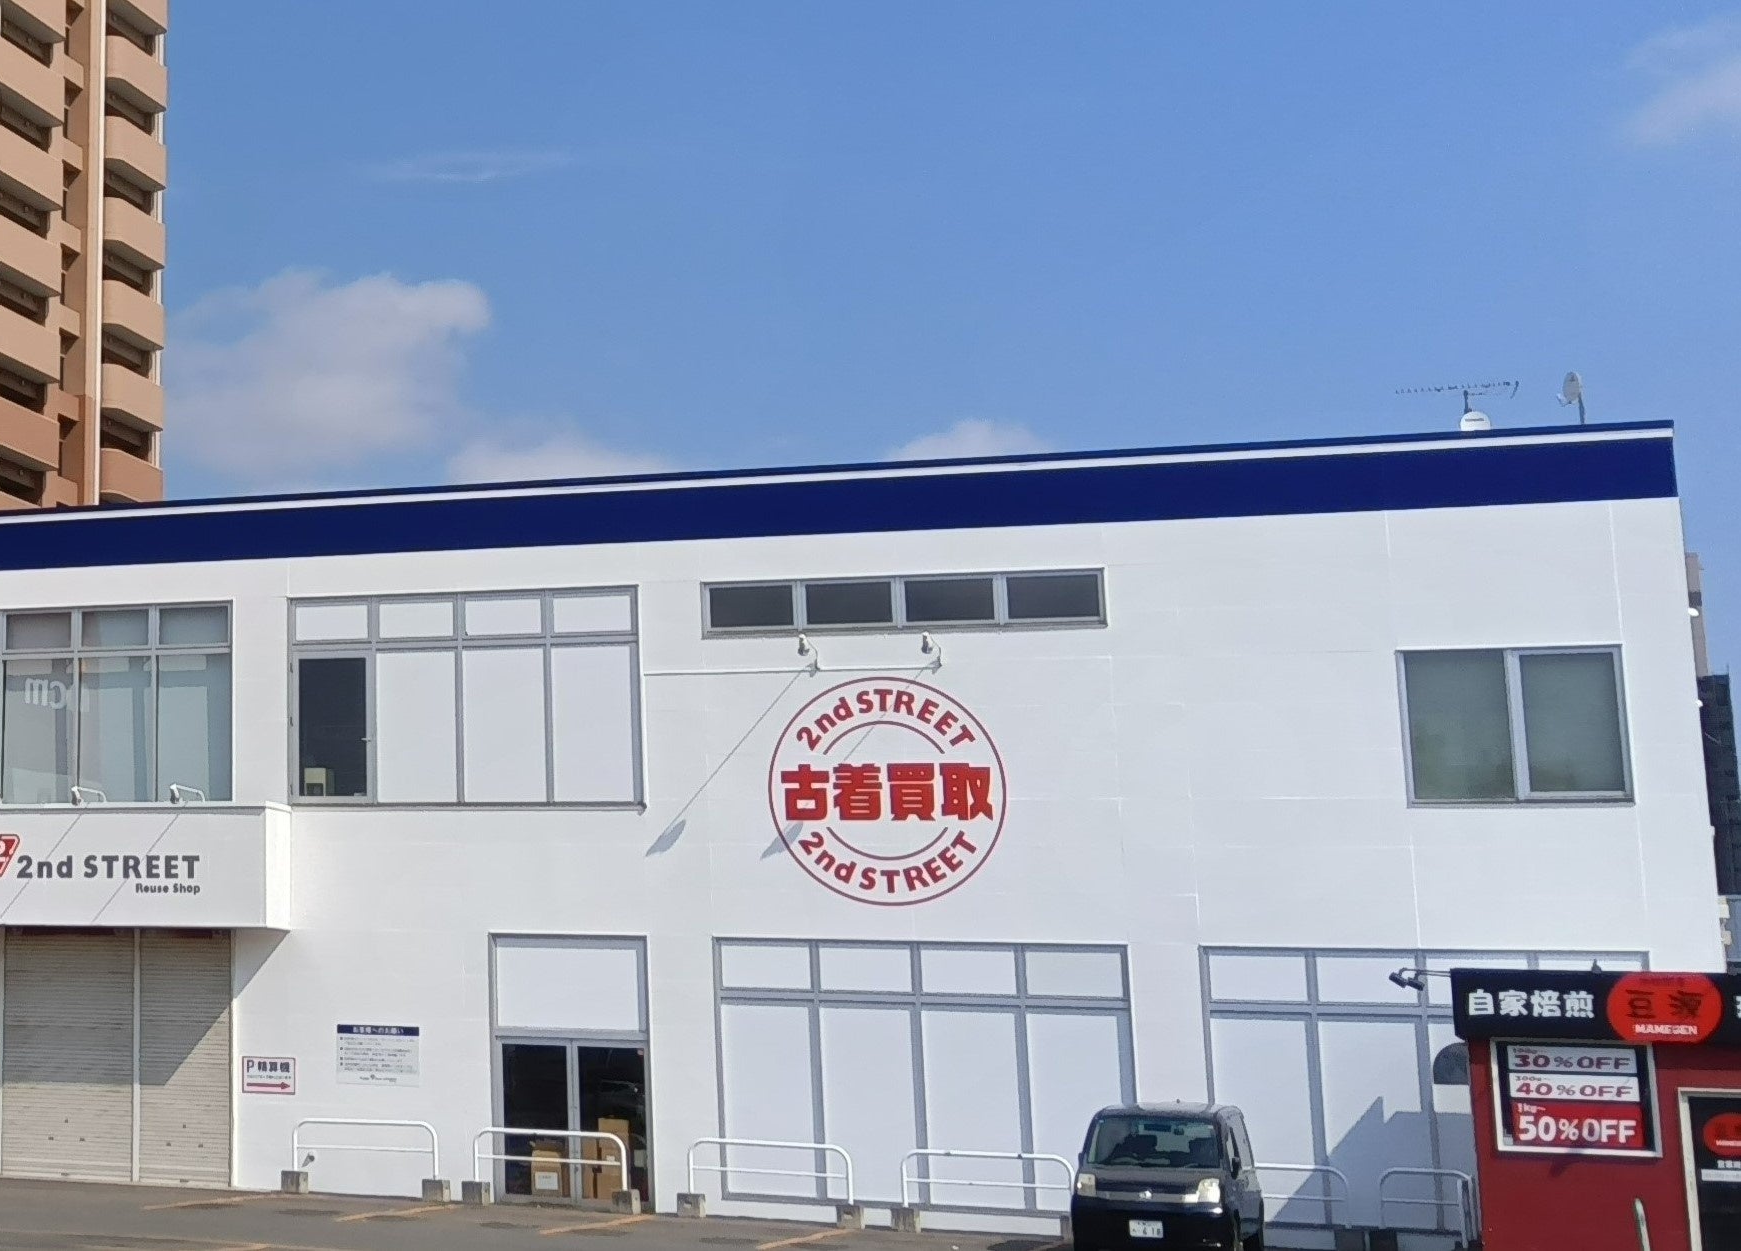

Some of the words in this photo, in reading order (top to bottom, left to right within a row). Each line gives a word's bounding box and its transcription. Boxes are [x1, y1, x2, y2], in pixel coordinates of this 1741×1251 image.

[796, 696, 854, 751] 2nd
[856, 688, 976, 747] STREET
[780, 763, 994, 822] 古着買取
[16, 855, 73, 879] 2nd
[83, 855, 200, 879] STREET
[798, 831, 857, 884] 2nd
[859, 830, 977, 894] STREET
[135, 883, 169, 894] Reuse
[172, 883, 201, 895] Shop
[1468, 989, 1595, 1019] 自家焙煎
[247, 1059, 255, 1073] P
[1514, 1054, 1631, 1070] 30%OFF
[1516, 1082, 1633, 1097] 40%OFF
[1519, 1115, 1637, 1143] 50%OFF
